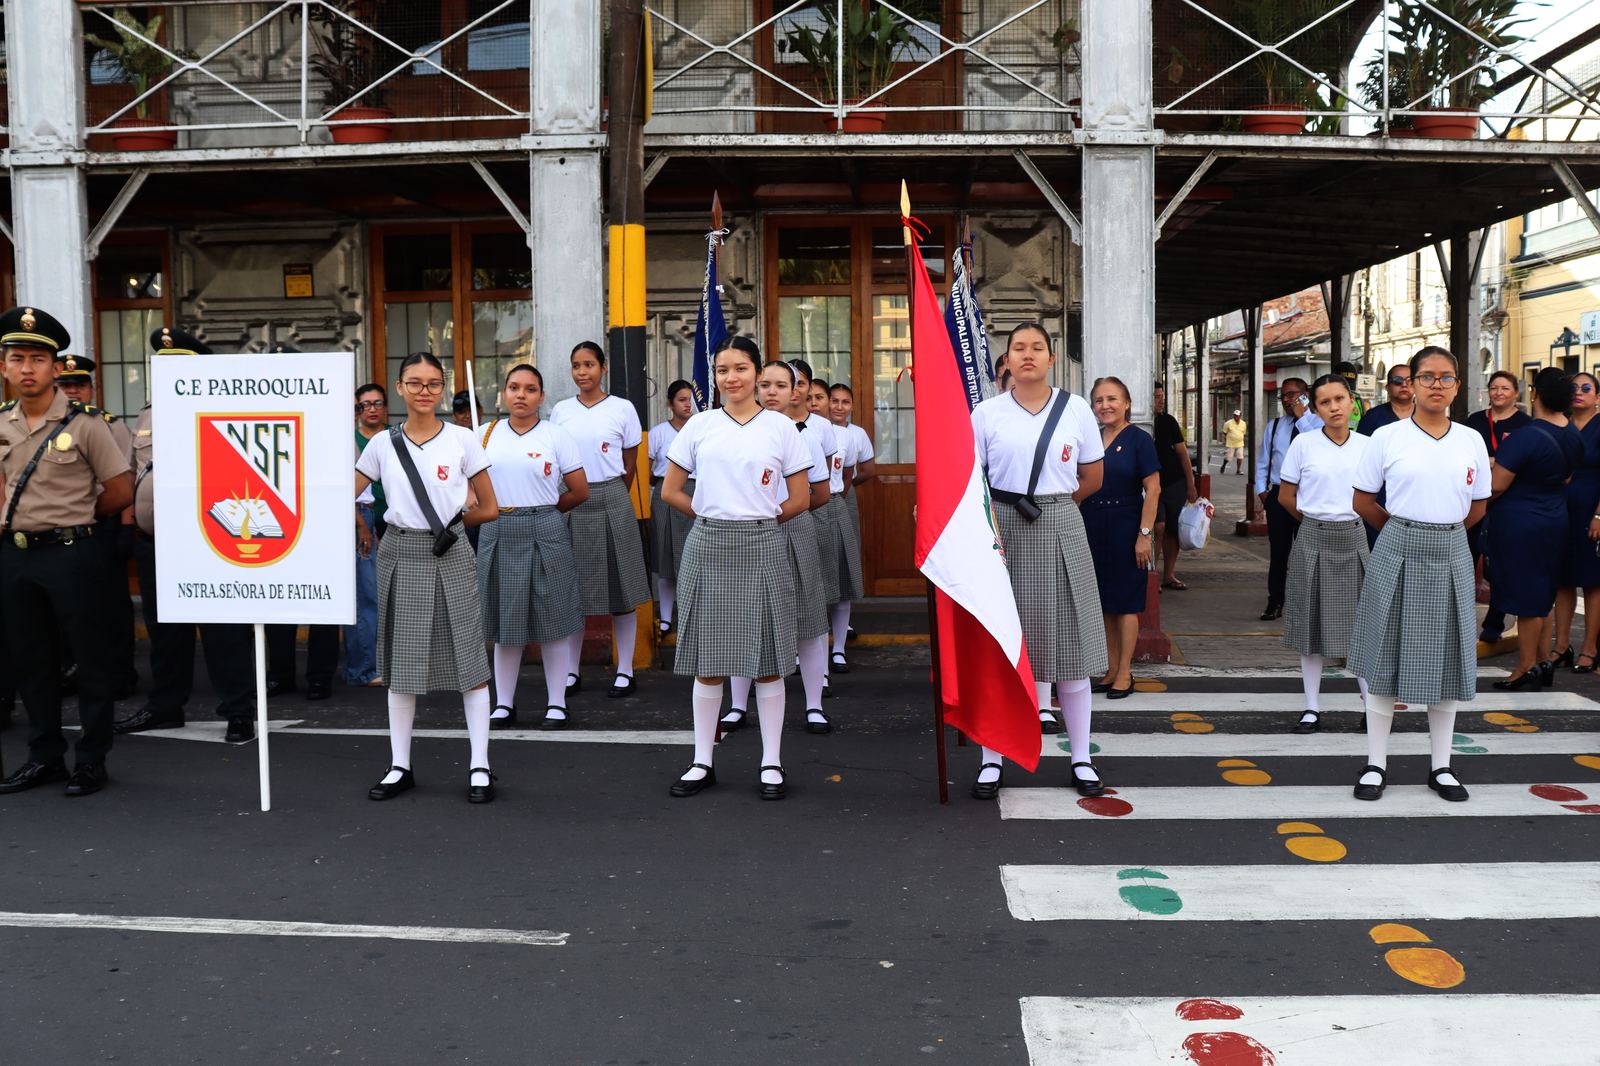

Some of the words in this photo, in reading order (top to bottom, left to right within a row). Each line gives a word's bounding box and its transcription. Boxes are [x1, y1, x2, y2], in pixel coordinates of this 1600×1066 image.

[951, 282, 972, 363] MUNICIPALIDAD
[965, 366, 980, 408] DISTRITAL
[174, 378, 202, 396] C.E
[208, 378, 329, 398] PARROQUIAL
[227, 423, 291, 491] NSF
[269, 584, 284, 599] DE
[287, 584, 332, 600] FATIMA
